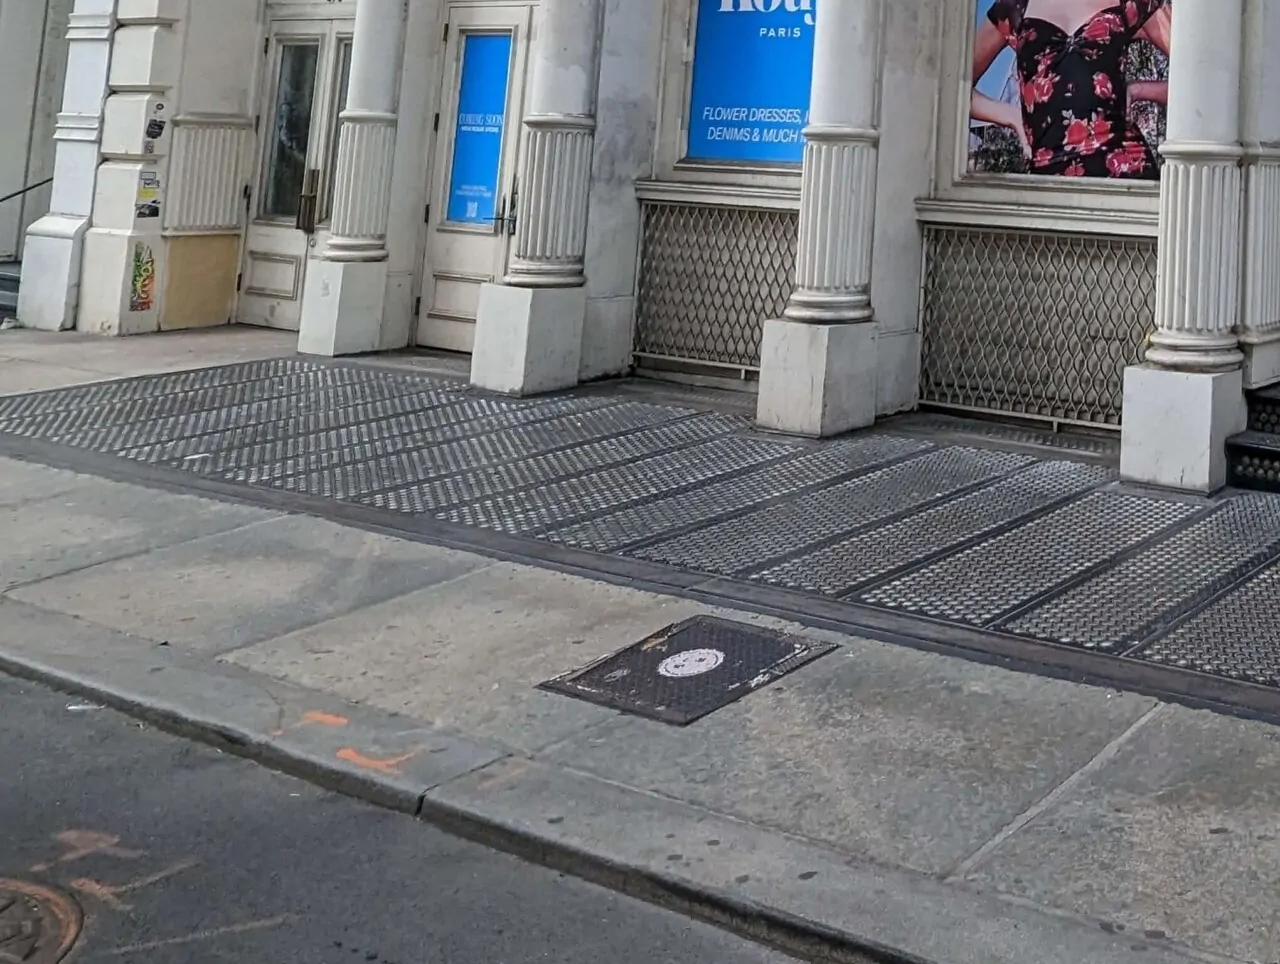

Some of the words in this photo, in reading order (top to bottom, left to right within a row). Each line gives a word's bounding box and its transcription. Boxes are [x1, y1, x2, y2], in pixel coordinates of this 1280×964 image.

[759, 27, 801, 38] PARIS
[702, 106, 748, 121] FLOWER
[707, 127, 750, 142] DENIMS
[752, 128, 760, 142] &
[762, 128, 798, 143] MUCH
